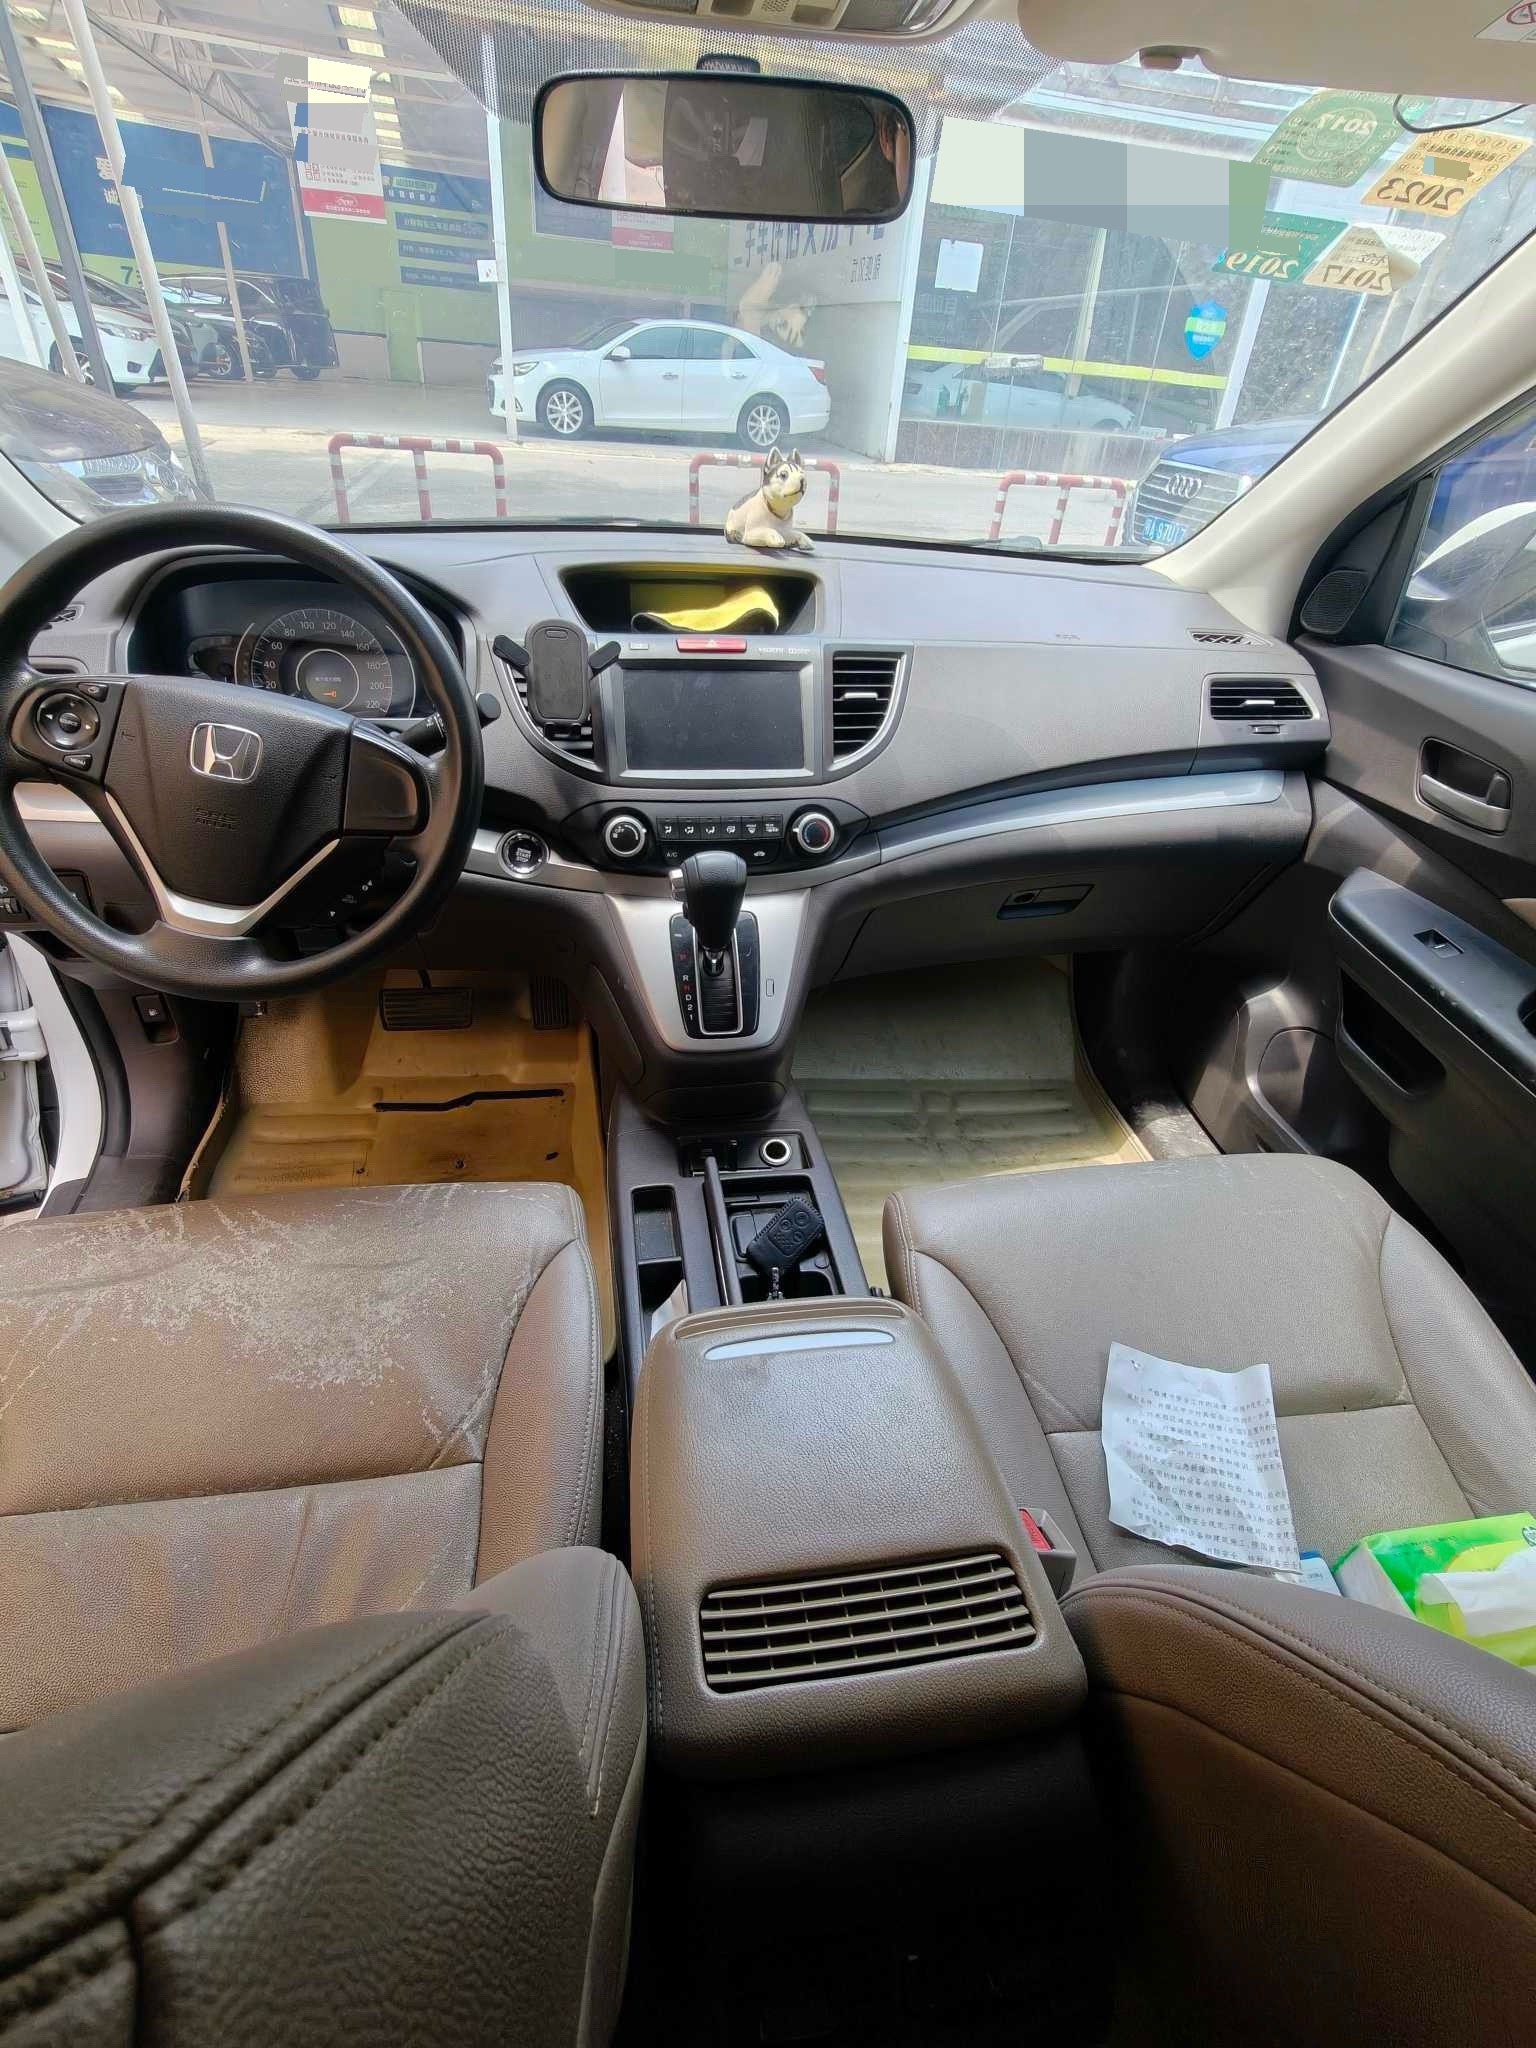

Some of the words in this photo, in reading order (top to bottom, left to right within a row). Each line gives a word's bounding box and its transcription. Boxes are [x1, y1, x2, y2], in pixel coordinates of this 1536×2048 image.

[299, 621, 315, 631] 100
[322, 622, 337, 630] 120
[283, 628, 296, 637] 80
[340, 629, 355, 638] 140
[271, 642, 283, 650] 60
[356, 643, 370, 651] 160
[263, 661, 276, 670] 40
[367, 662, 381, 670] 180
[265, 681, 277, 689] 20
[370, 681, 384, 690] 200
[366, 700, 380, 709] 220
